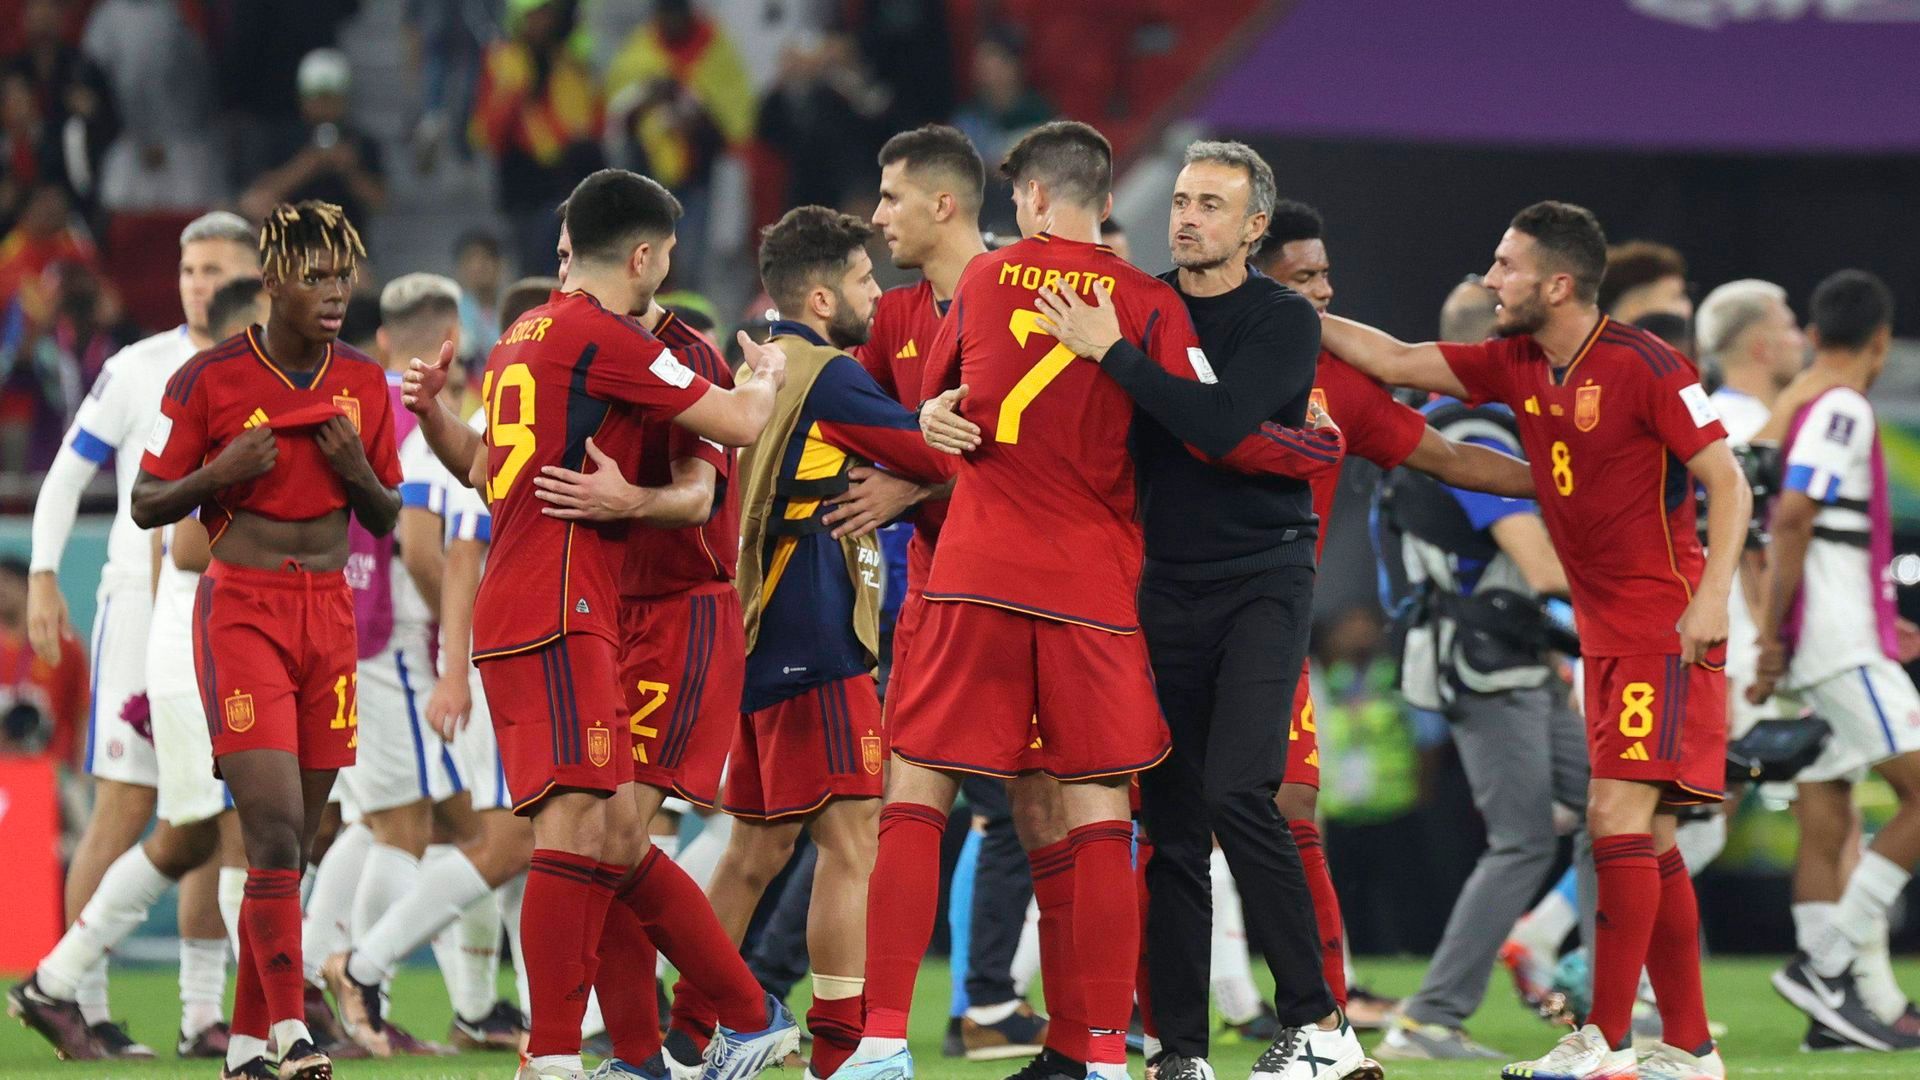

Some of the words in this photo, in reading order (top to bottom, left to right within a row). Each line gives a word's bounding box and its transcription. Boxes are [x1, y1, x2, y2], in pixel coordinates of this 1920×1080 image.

[995, 308, 1078, 445] 7
[1551, 440, 1575, 497] 8
[629, 679, 670, 739] 2
[1618, 681, 1656, 738] 8
